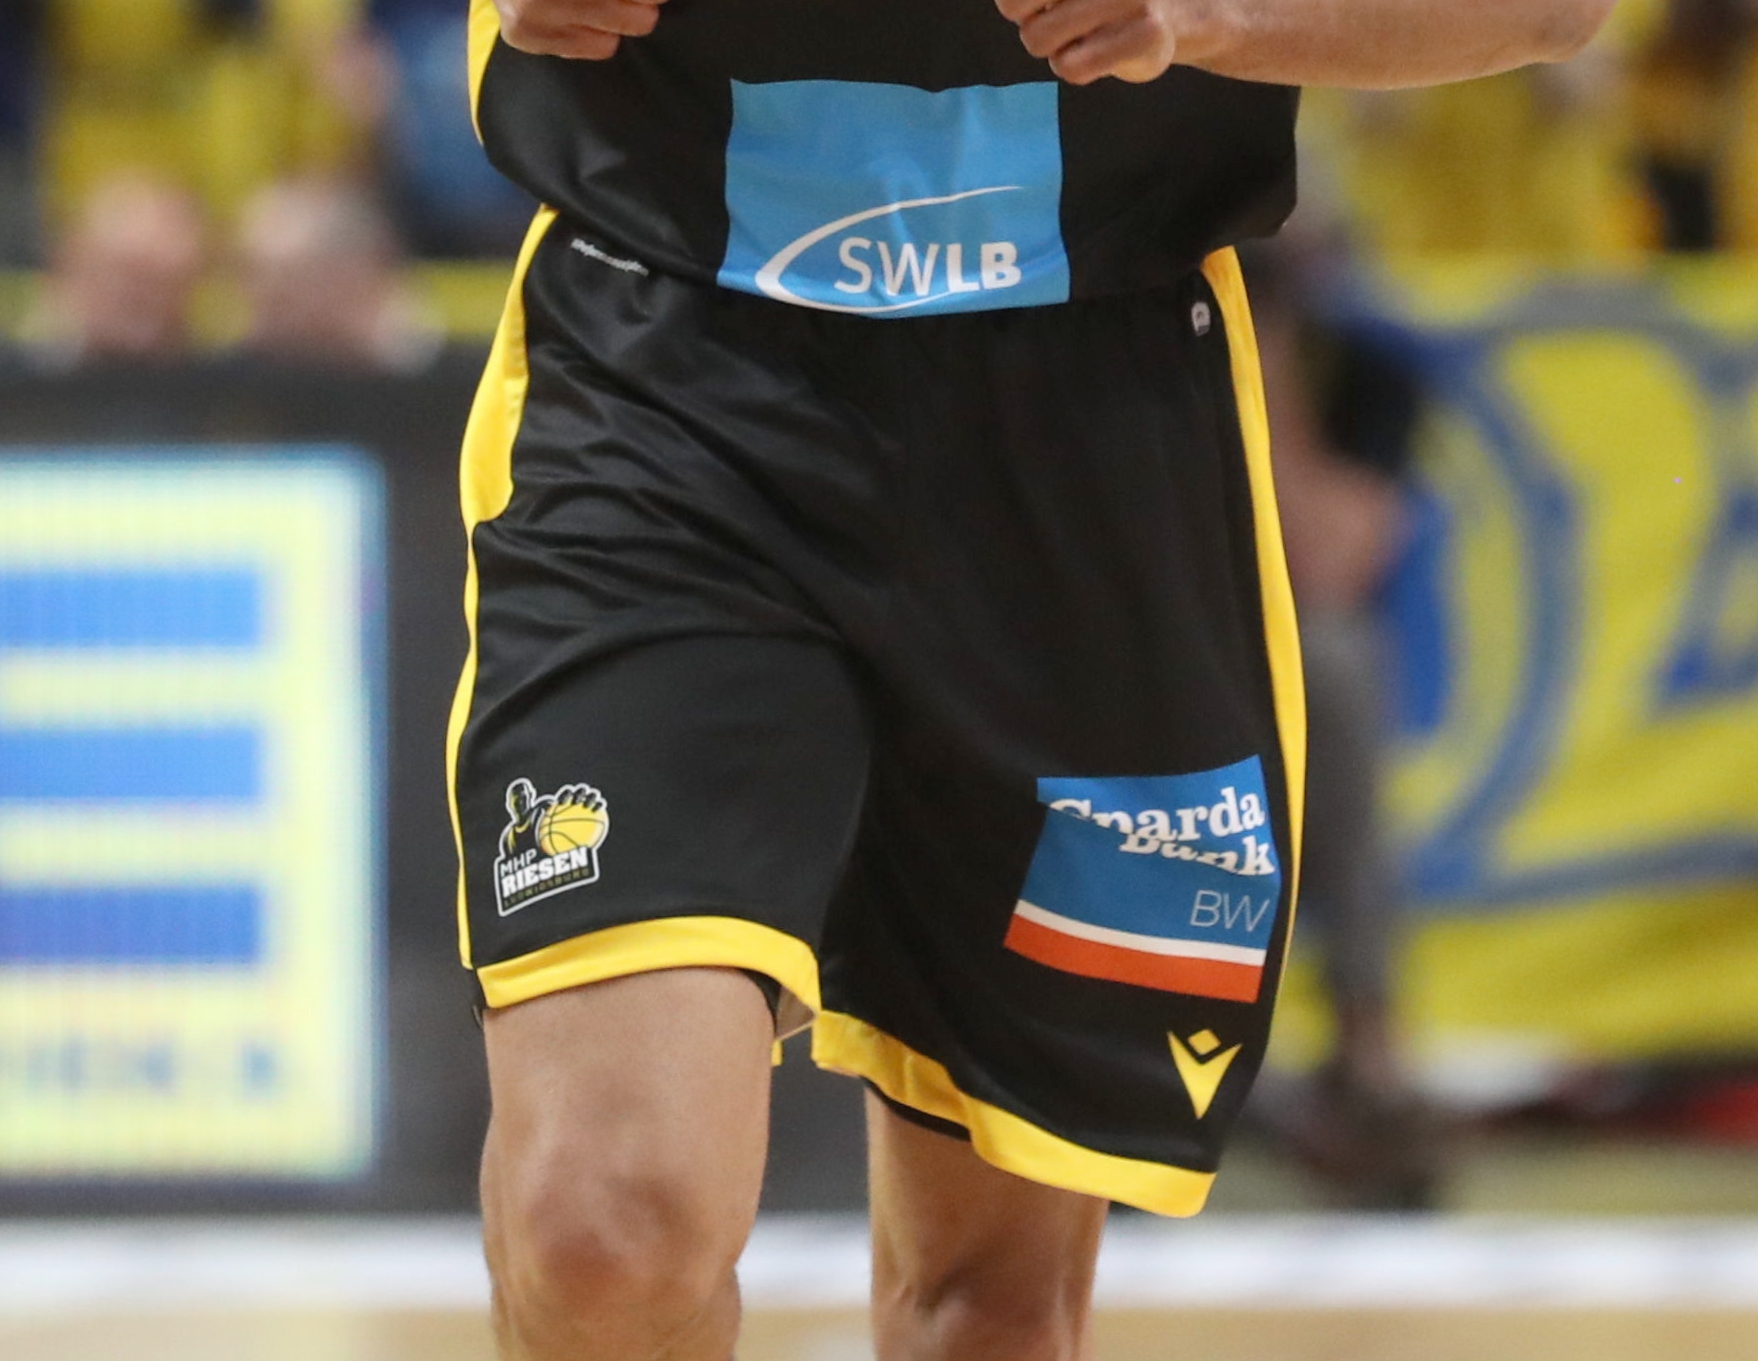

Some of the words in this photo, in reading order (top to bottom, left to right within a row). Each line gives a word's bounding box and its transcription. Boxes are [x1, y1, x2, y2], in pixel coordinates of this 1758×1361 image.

[833, 238, 1022, 296] SWLB
[500, 848, 538, 878] MHP
[501, 846, 589, 898] RIESEN
[1190, 889, 1270, 932] BW
